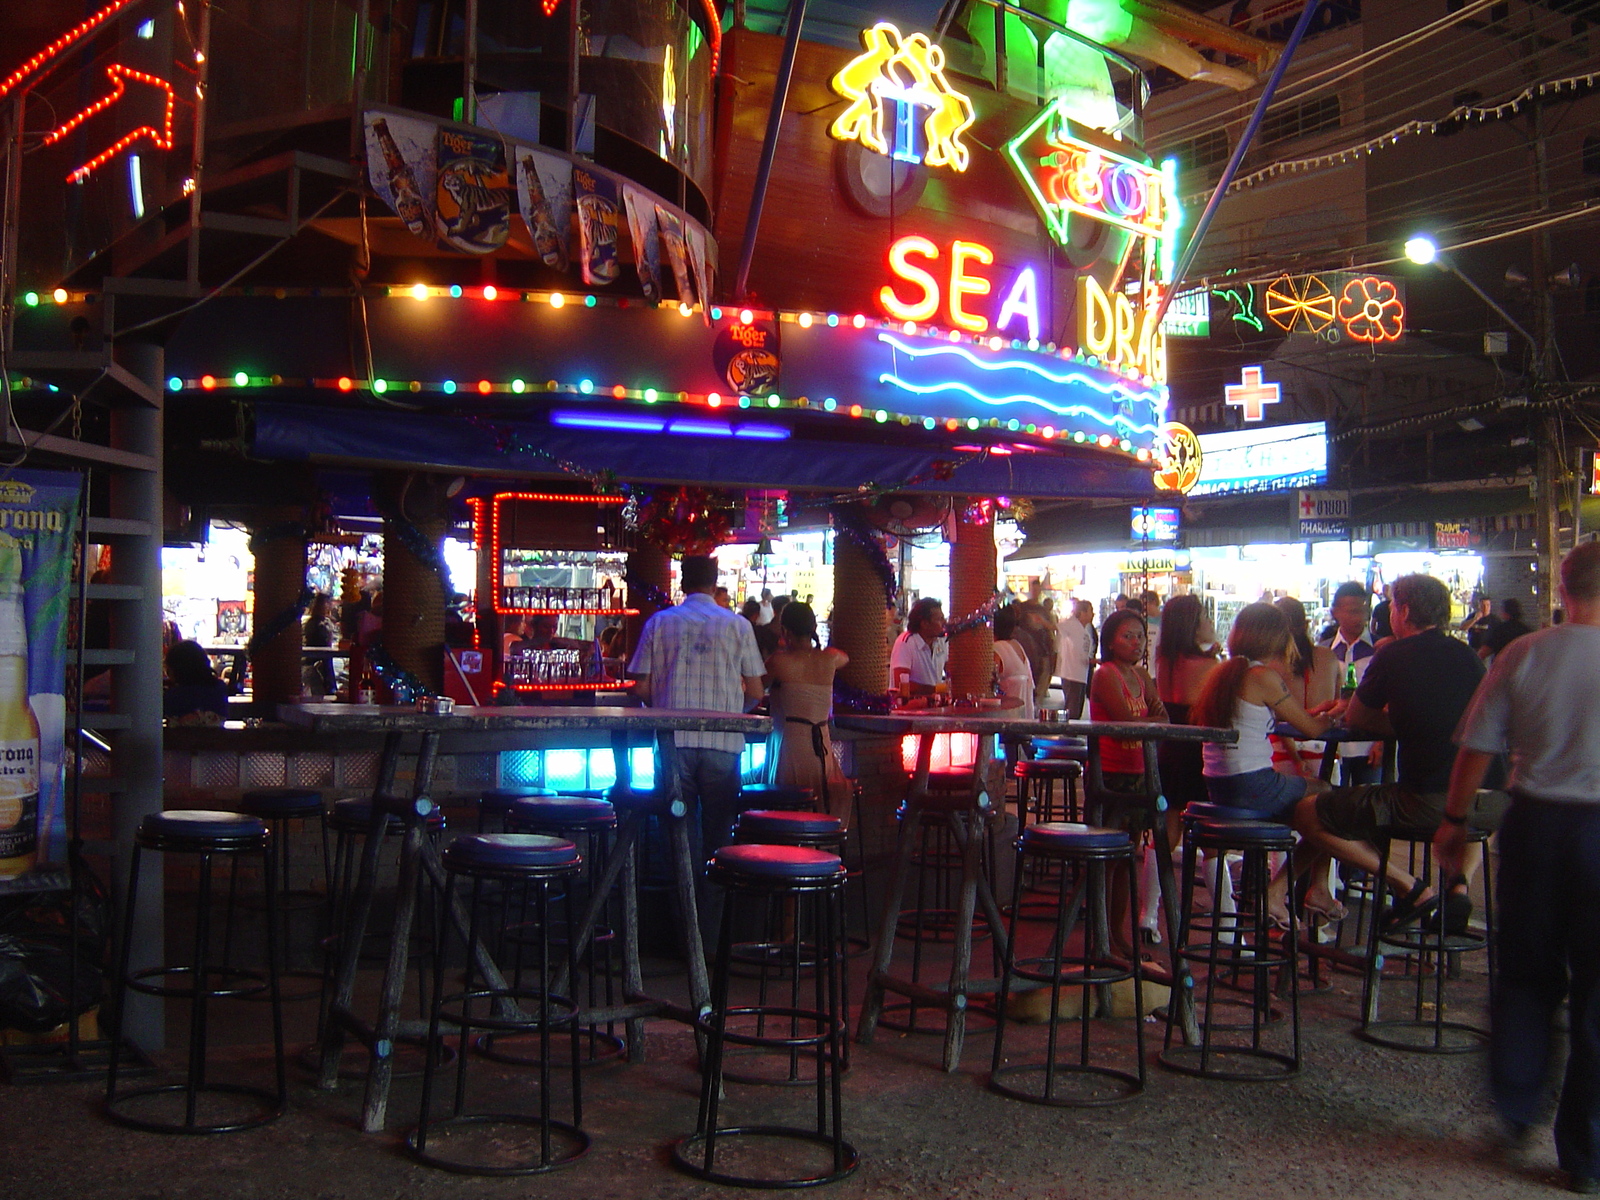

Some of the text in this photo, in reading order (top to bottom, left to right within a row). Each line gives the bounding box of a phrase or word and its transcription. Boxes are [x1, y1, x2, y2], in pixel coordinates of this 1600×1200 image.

[443, 132, 473, 153] Tiger
[575, 169, 596, 191] Tiger
[879, 235, 1040, 340] SEA
[730, 325, 766, 347] Tiger
[0, 509, 63, 533] rona
[1436, 529, 1470, 548] TATTOO
